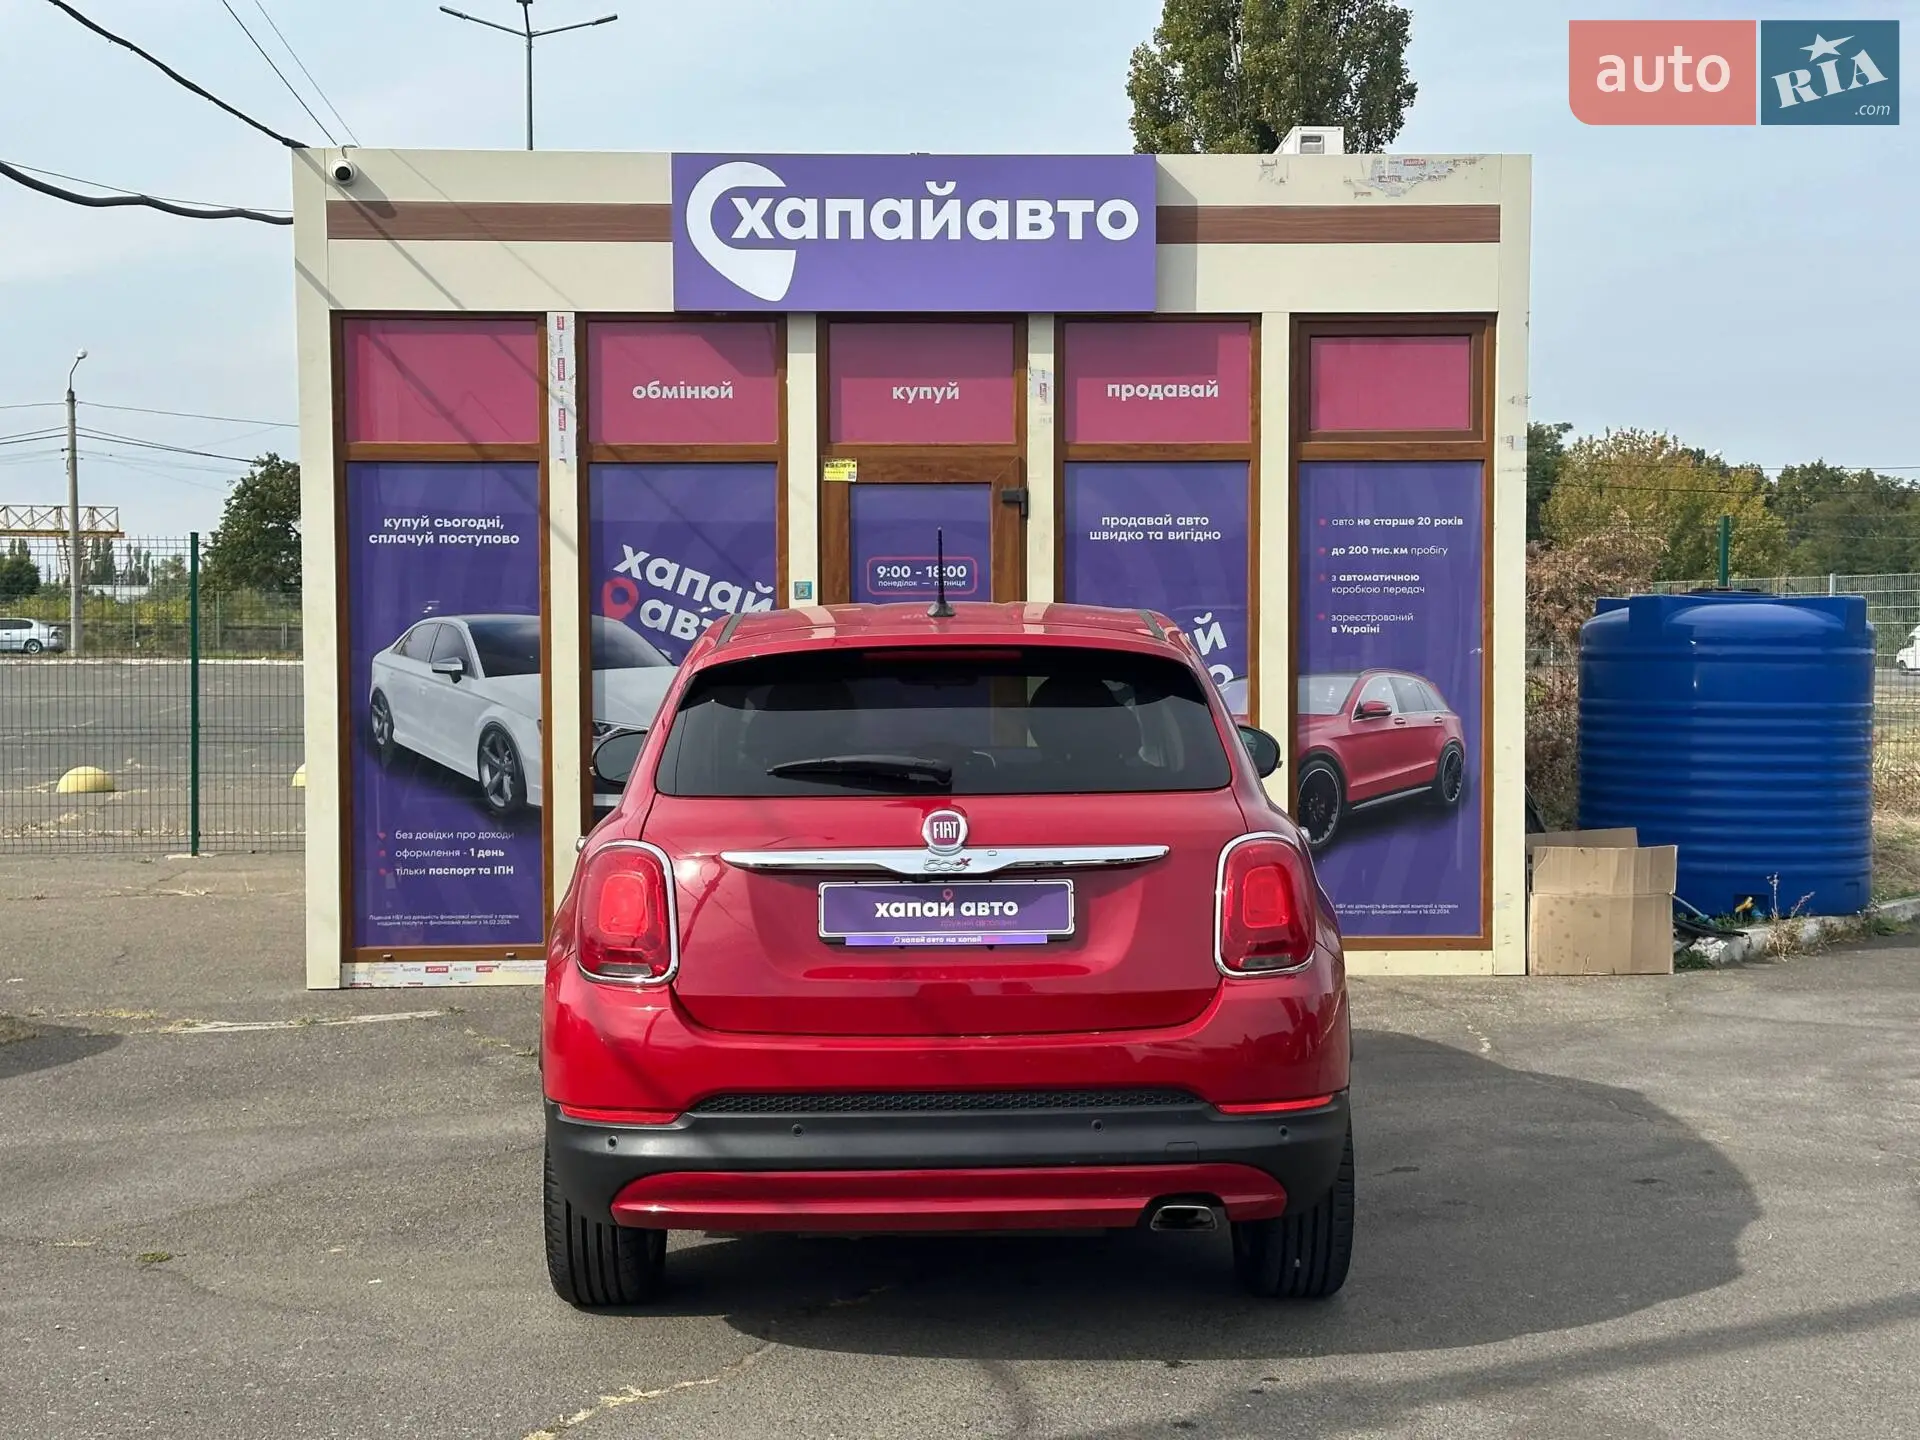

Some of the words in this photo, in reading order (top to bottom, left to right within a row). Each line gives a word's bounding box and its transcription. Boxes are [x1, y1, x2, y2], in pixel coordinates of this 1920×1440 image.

[730, 180, 1139, 241] хапайавто
[632, 380, 734, 399] обмінюй
[892, 381, 959, 404] купуй
[1107, 379, 1219, 401] продавай
[383, 515, 429, 530] купуй
[434, 515, 504, 530] сьогодні,
[1101, 514, 1172, 528] продавай
[1176, 516, 1209, 526] авто
[1331, 517, 1355, 526] авто
[1357, 517, 1370, 526] не
[1373, 517, 1415, 527] старше
[1417, 516, 1431, 526] 20
[1434, 516, 1464, 528] років
[368, 532, 434, 546] сплачуй
[439, 534, 519, 546] поступово
[1089, 530, 1144, 542] швидко
[1148, 531, 1163, 541] та
[1168, 528, 1222, 542] вигідно
[1331, 547, 1346, 556] до
[1348, 546, 1369, 555] 200
[1411, 545, 1448, 556] пробігу
[877, 566, 911, 578] 9:00
[926, 565, 967, 578] 18:00
[1331, 574, 1337, 582] з
[1339, 573, 1420, 582] автоматичною
[613, 544, 774, 615] хапай
[1331, 585, 1381, 594] коробкою
[1383, 586, 1425, 594] передач
[1331, 612, 1414, 622] зареєстрований
[1340, 624, 1380, 634] Україні
[395, 830, 413, 840] без
[415, 831, 453, 840] довідки
[456, 832, 475, 841] про
[477, 831, 515, 840] доходи
[933, 821, 958, 839] FIAT
[395, 849, 461, 858] оформлення
[469, 848, 475, 857] 1
[477, 849, 505, 858] день
[395, 866, 426, 876] тільки
[429, 867, 475, 877] паспорт
[478, 867, 490, 876] та
[494, 865, 514, 875] ІПН
[960, 901, 1019, 916] авто
